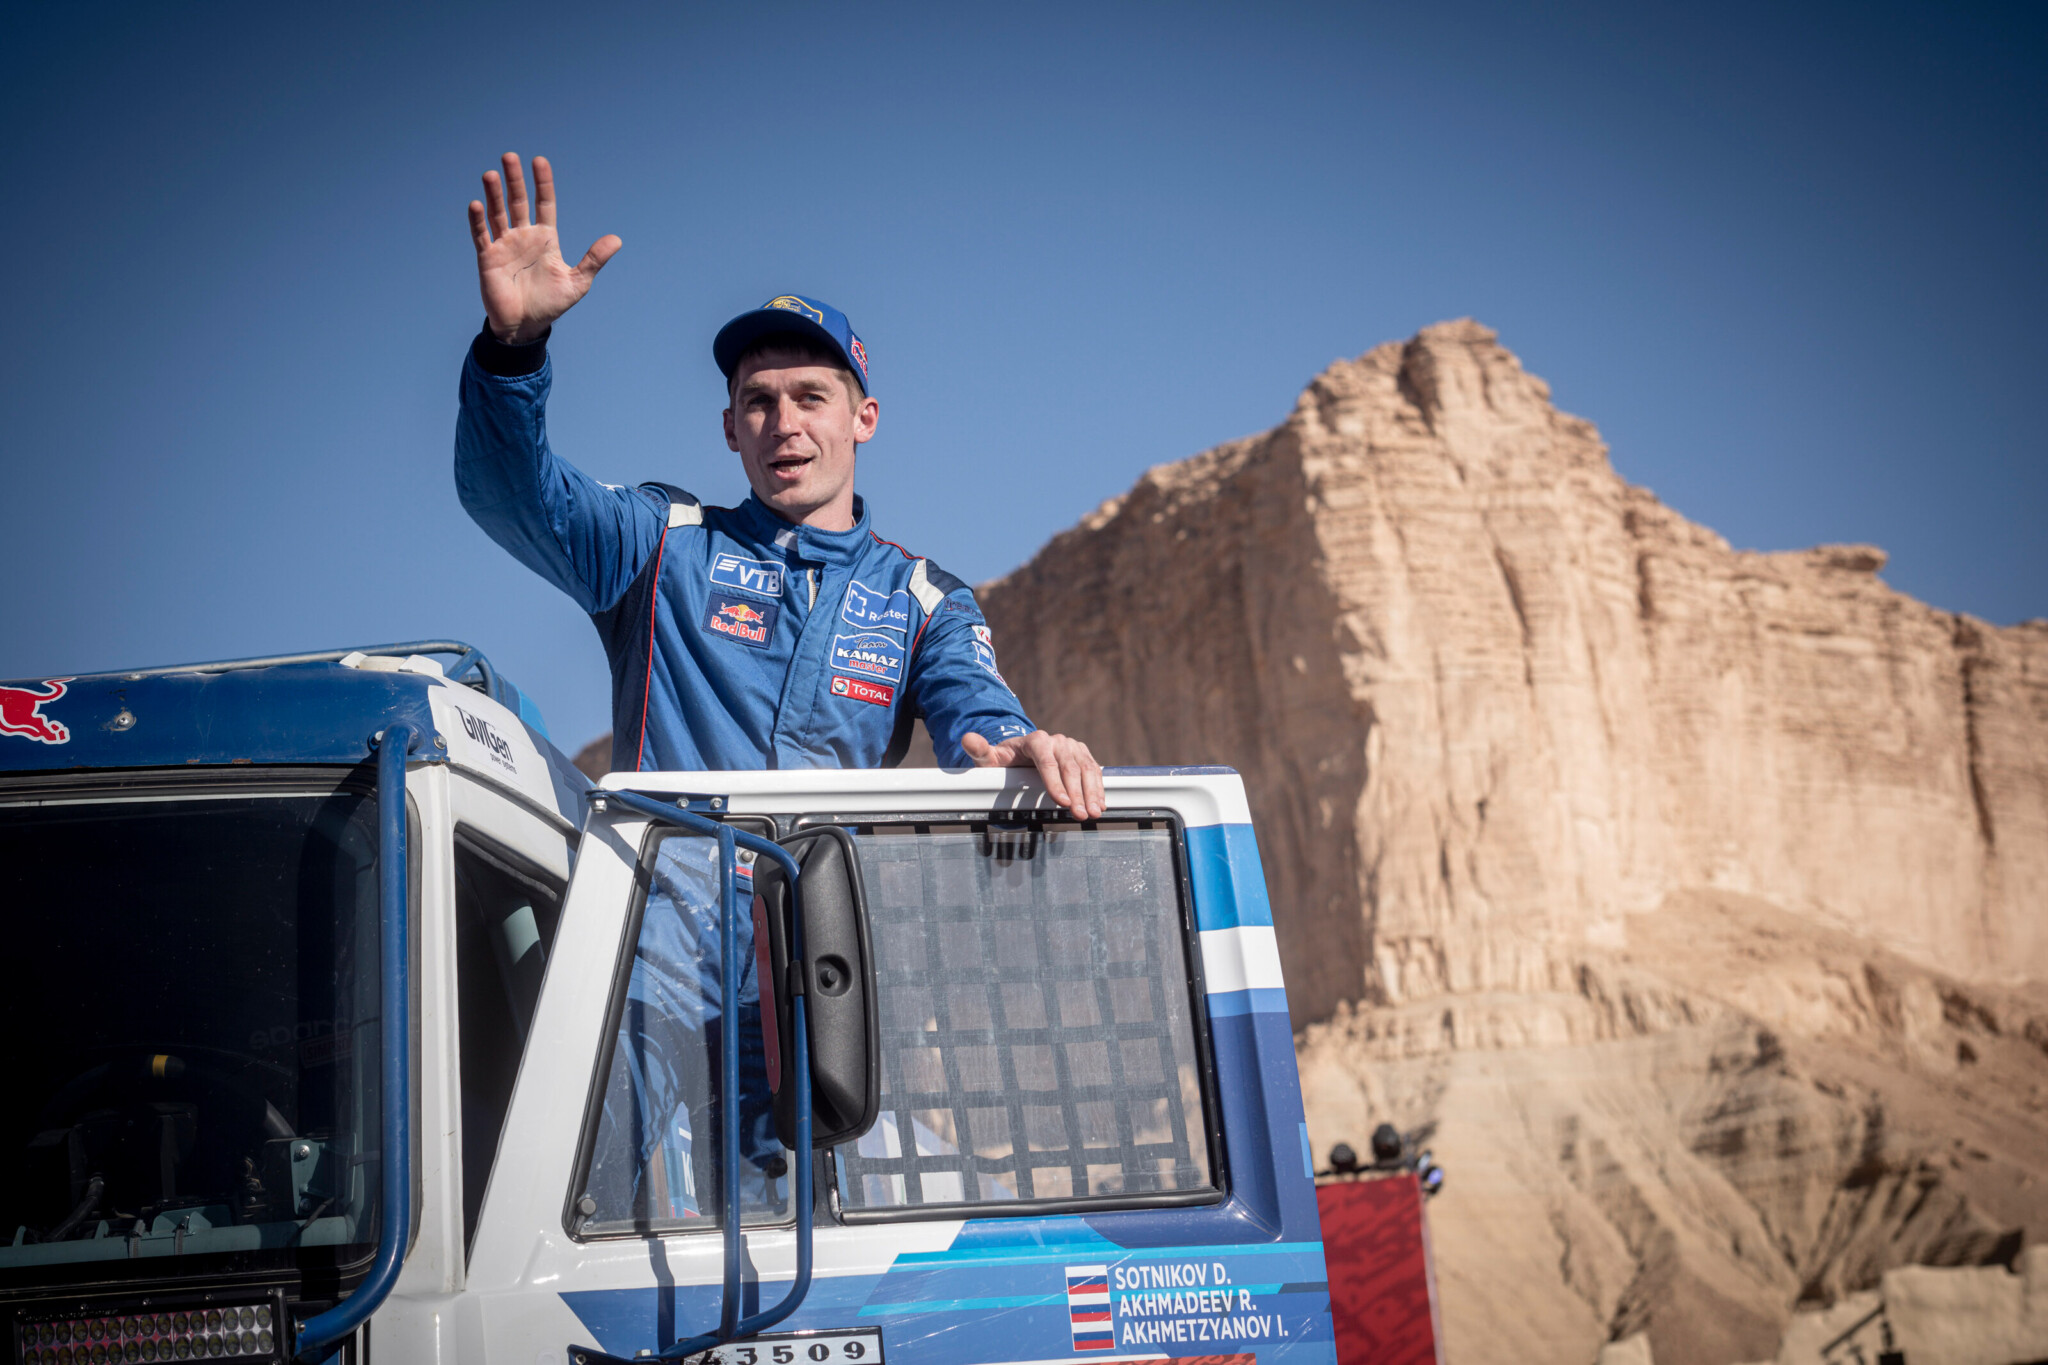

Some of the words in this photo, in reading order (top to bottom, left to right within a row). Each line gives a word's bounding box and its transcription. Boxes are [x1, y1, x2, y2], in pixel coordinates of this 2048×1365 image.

[739, 565, 780, 592] VTB
[710, 615, 739, 636] Red
[738, 623, 767, 642] Bull
[868, 609, 908, 622] Rostec
[854, 637, 888, 648] Team
[836, 648, 899, 669] KAMAZ
[848, 659, 888, 674] master
[1115, 1263, 1207, 1290] SOTNIKOV
[1213, 1262, 1231, 1285] D.
[1119, 1290, 1233, 1318] AKHMADEEV
[1238, 1289, 1257, 1311] R.
[1122, 1315, 1271, 1345] AKHMETZYANOV
[1277, 1314, 1289, 1337] I.
